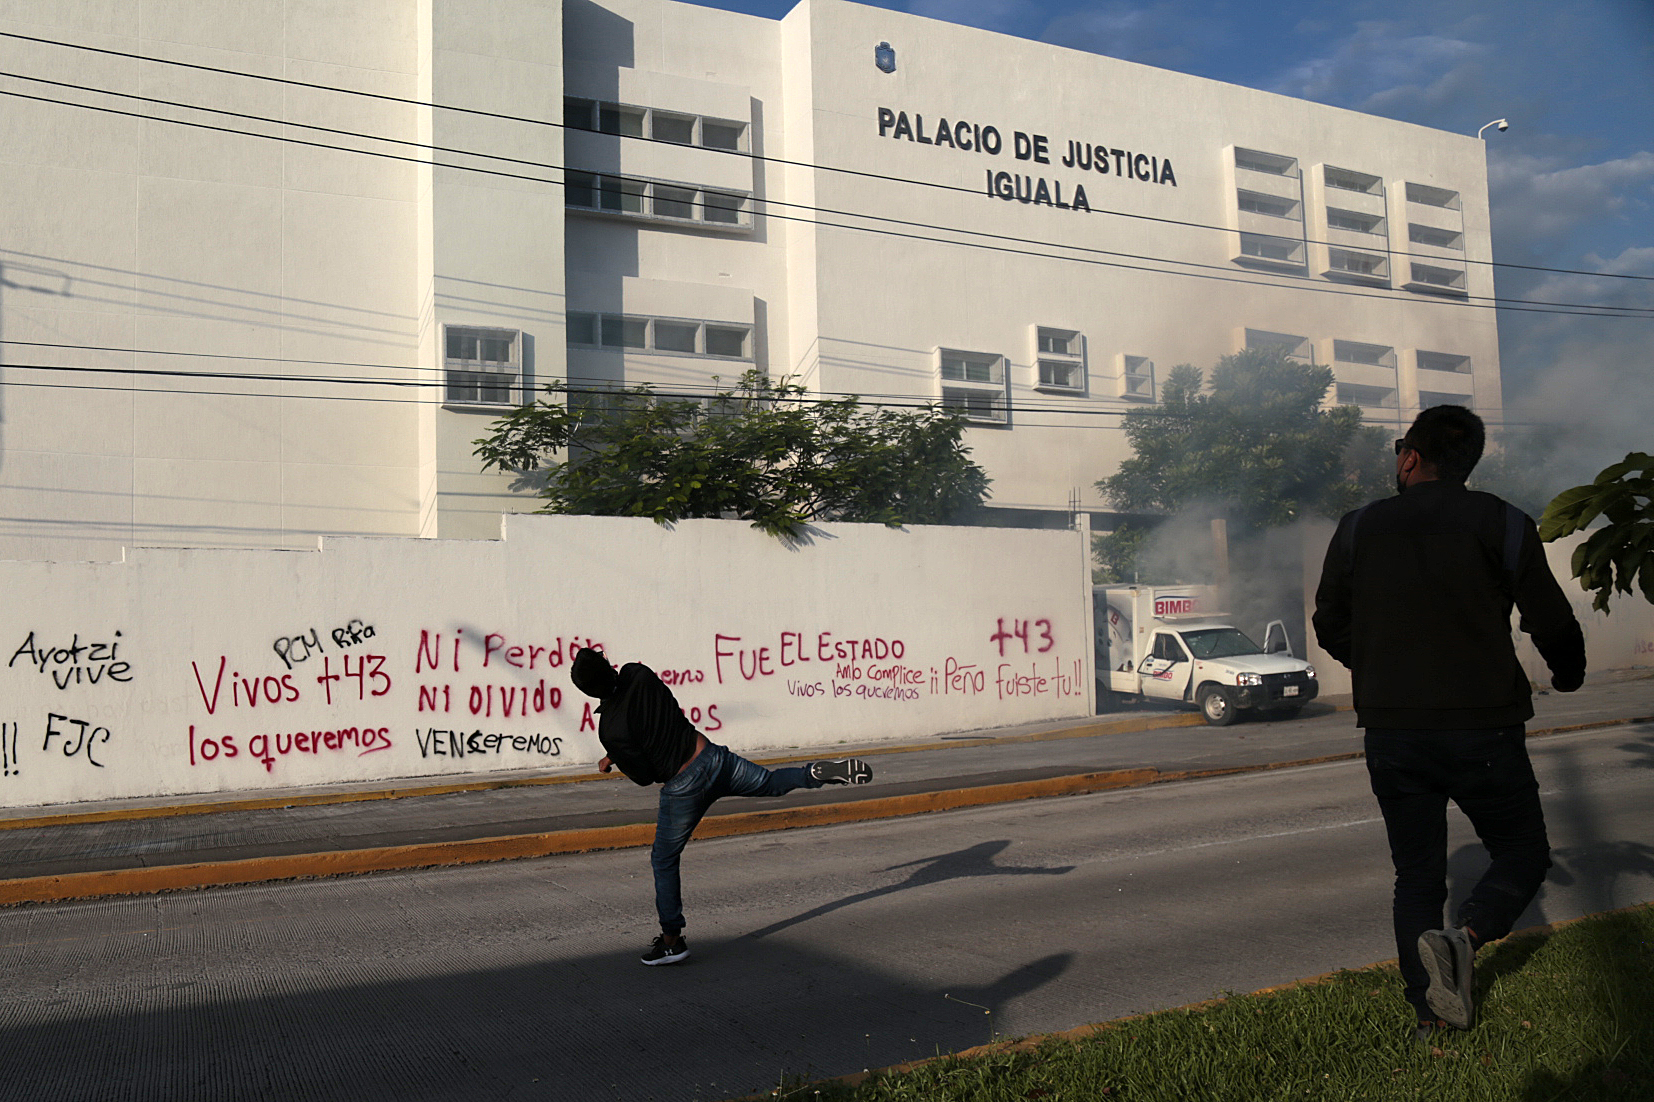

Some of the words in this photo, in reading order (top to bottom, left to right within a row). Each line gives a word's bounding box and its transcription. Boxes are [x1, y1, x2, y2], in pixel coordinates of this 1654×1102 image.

[878, 106, 1001, 155] PALACIO
[1014, 130, 1050, 165] DE
[1062, 139, 1177, 187] JUSTICIA
[986, 169, 1091, 213] IGUALA
[9, 630, 123, 674] Ayotzi
[714, 633, 774, 685] FUE
[780, 631, 811, 667] EL
[990, 617, 1056, 657] +43
[191, 655, 301, 715] Vivos
[316, 654, 393, 705] +43
[787, 679, 826, 698] Vivos
[831, 679, 853, 699] los
[866, 663, 926, 689] Complice
[43, 712, 111, 768] FJC
[188, 724, 240, 767] los
[249, 726, 393, 773] queremos
